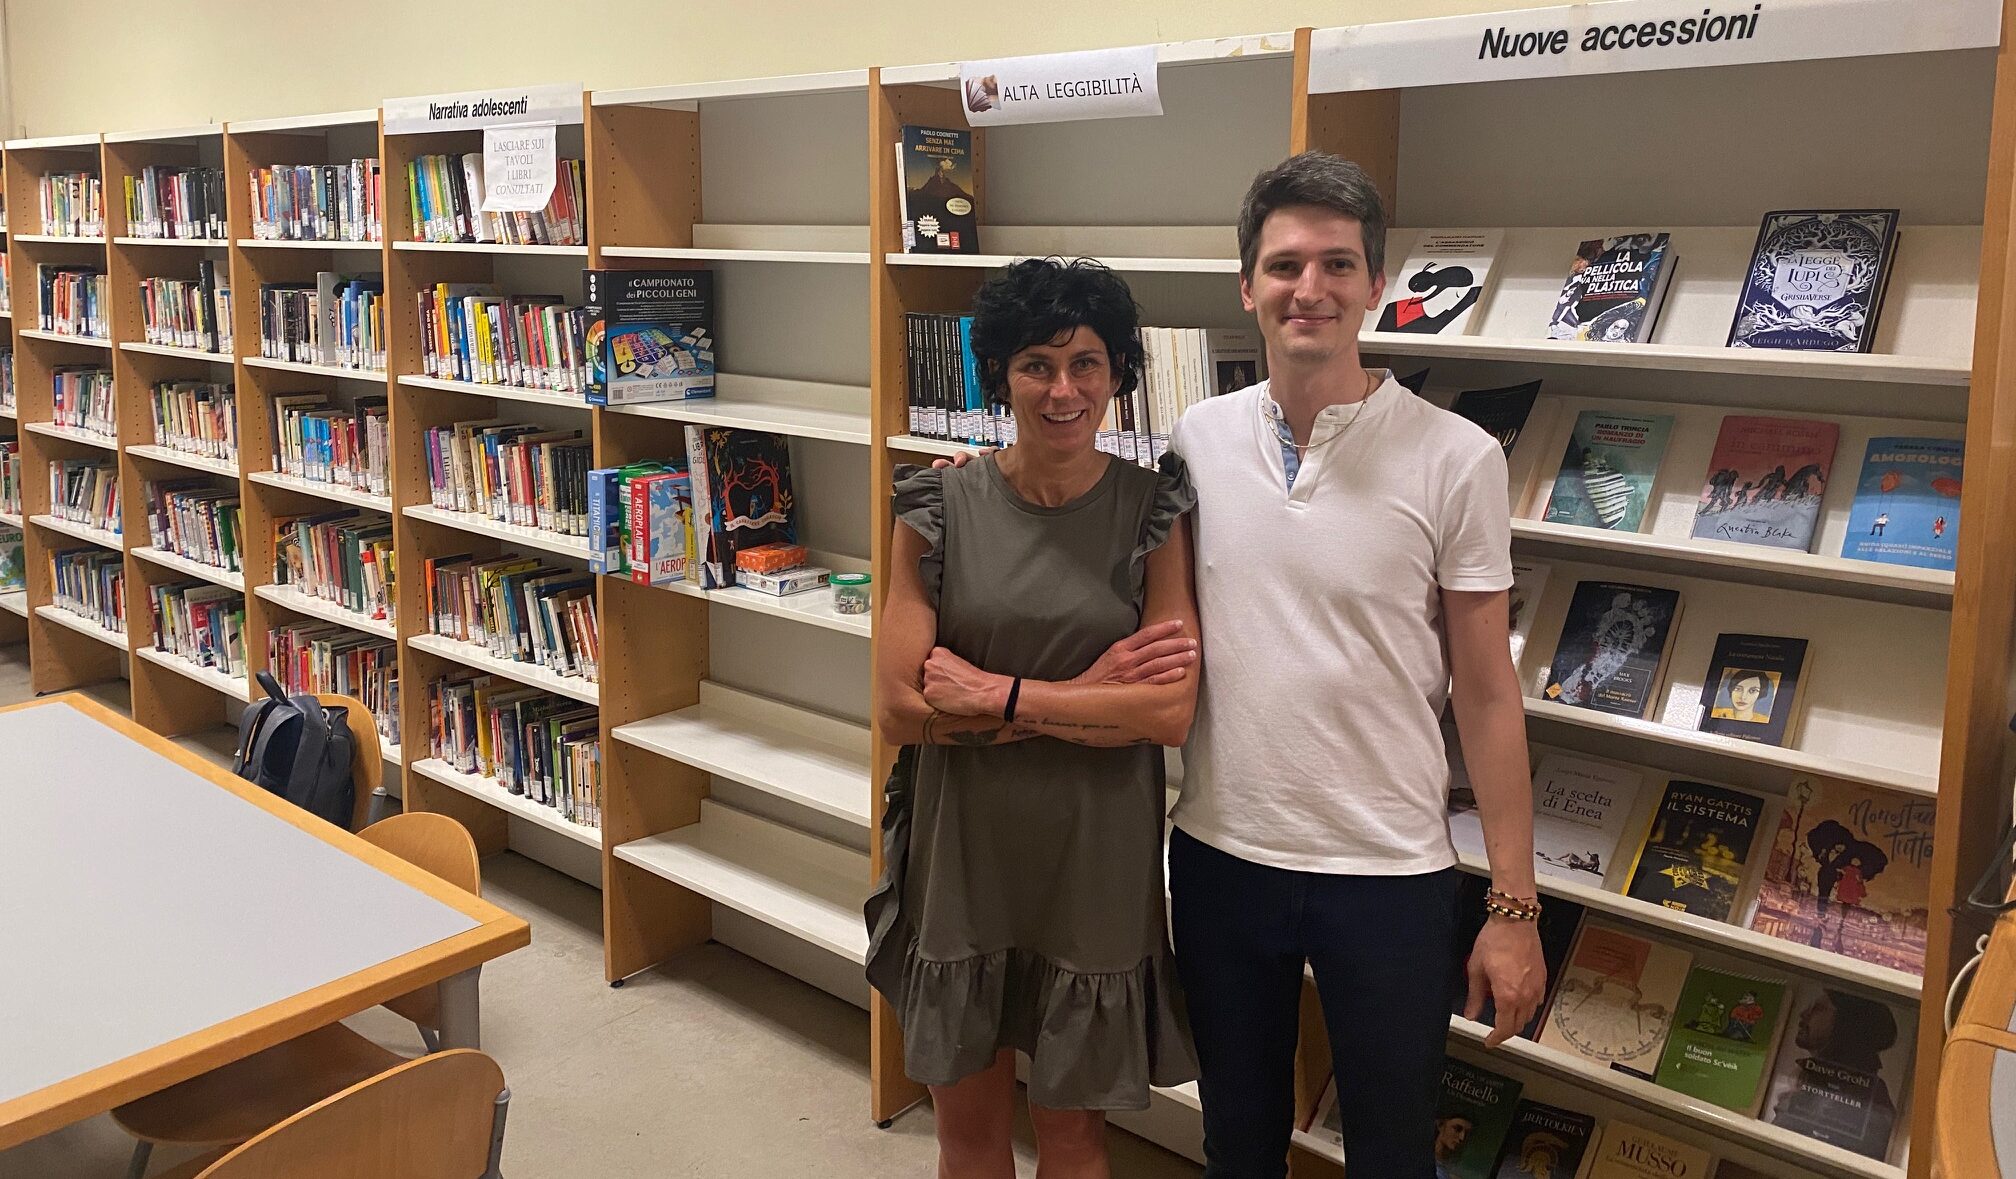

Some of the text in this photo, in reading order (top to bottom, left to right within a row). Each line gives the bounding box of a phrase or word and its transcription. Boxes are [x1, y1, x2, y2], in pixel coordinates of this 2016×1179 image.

[1478, 3, 1762, 60] Nuove accessioni
[1003, 72, 1142, 102] ALTA LEGGIBILITÀ
[428, 95, 528, 121] Narrativa adolescenti
[493, 138, 545, 153] LASCIARE SUI
[915, 144, 942, 153] ARRIVARE
[504, 156, 534, 166] TAVOLI
[511, 169, 532, 180] LIBRI
[495, 183, 544, 196] CONSULTATI
[1616, 251, 1631, 263] LA
[1799, 255, 1840, 267] LEGGE
[1583, 261, 1643, 278] PELLICOLA
[1788, 268, 1820, 283] LUPI
[633, 278, 694, 288] CAMPIONATO
[1581, 273, 1616, 284] VA NELLA
[1586, 279, 1639, 294] PLASTICA
[626, 289, 697, 299] dei PICCOLI GENI
[592, 498, 601, 532] TITANIC
[635, 493, 644, 542] L'AEROPLAN
[1716, 522, 1798, 539] Quentin Blake
[1545, 780, 1612, 808] La scelta
[1542, 795, 1559, 809] di
[1562, 798, 1603, 820] Enea
[1670, 791, 1752, 816] RYAN GATTIS
[1667, 801, 1749, 828] IL SISTEMA
[1684, 1052, 1712, 1064] soldato
[1693, 1046, 1712, 1057] buon
[1805, 1060, 1871, 1088] Dave Grohl
[1441, 1071, 1499, 1104] Raffaello
[1801, 1084, 1862, 1108] STORYTELLER
[1617, 1140, 1687, 1177] MUSSO
